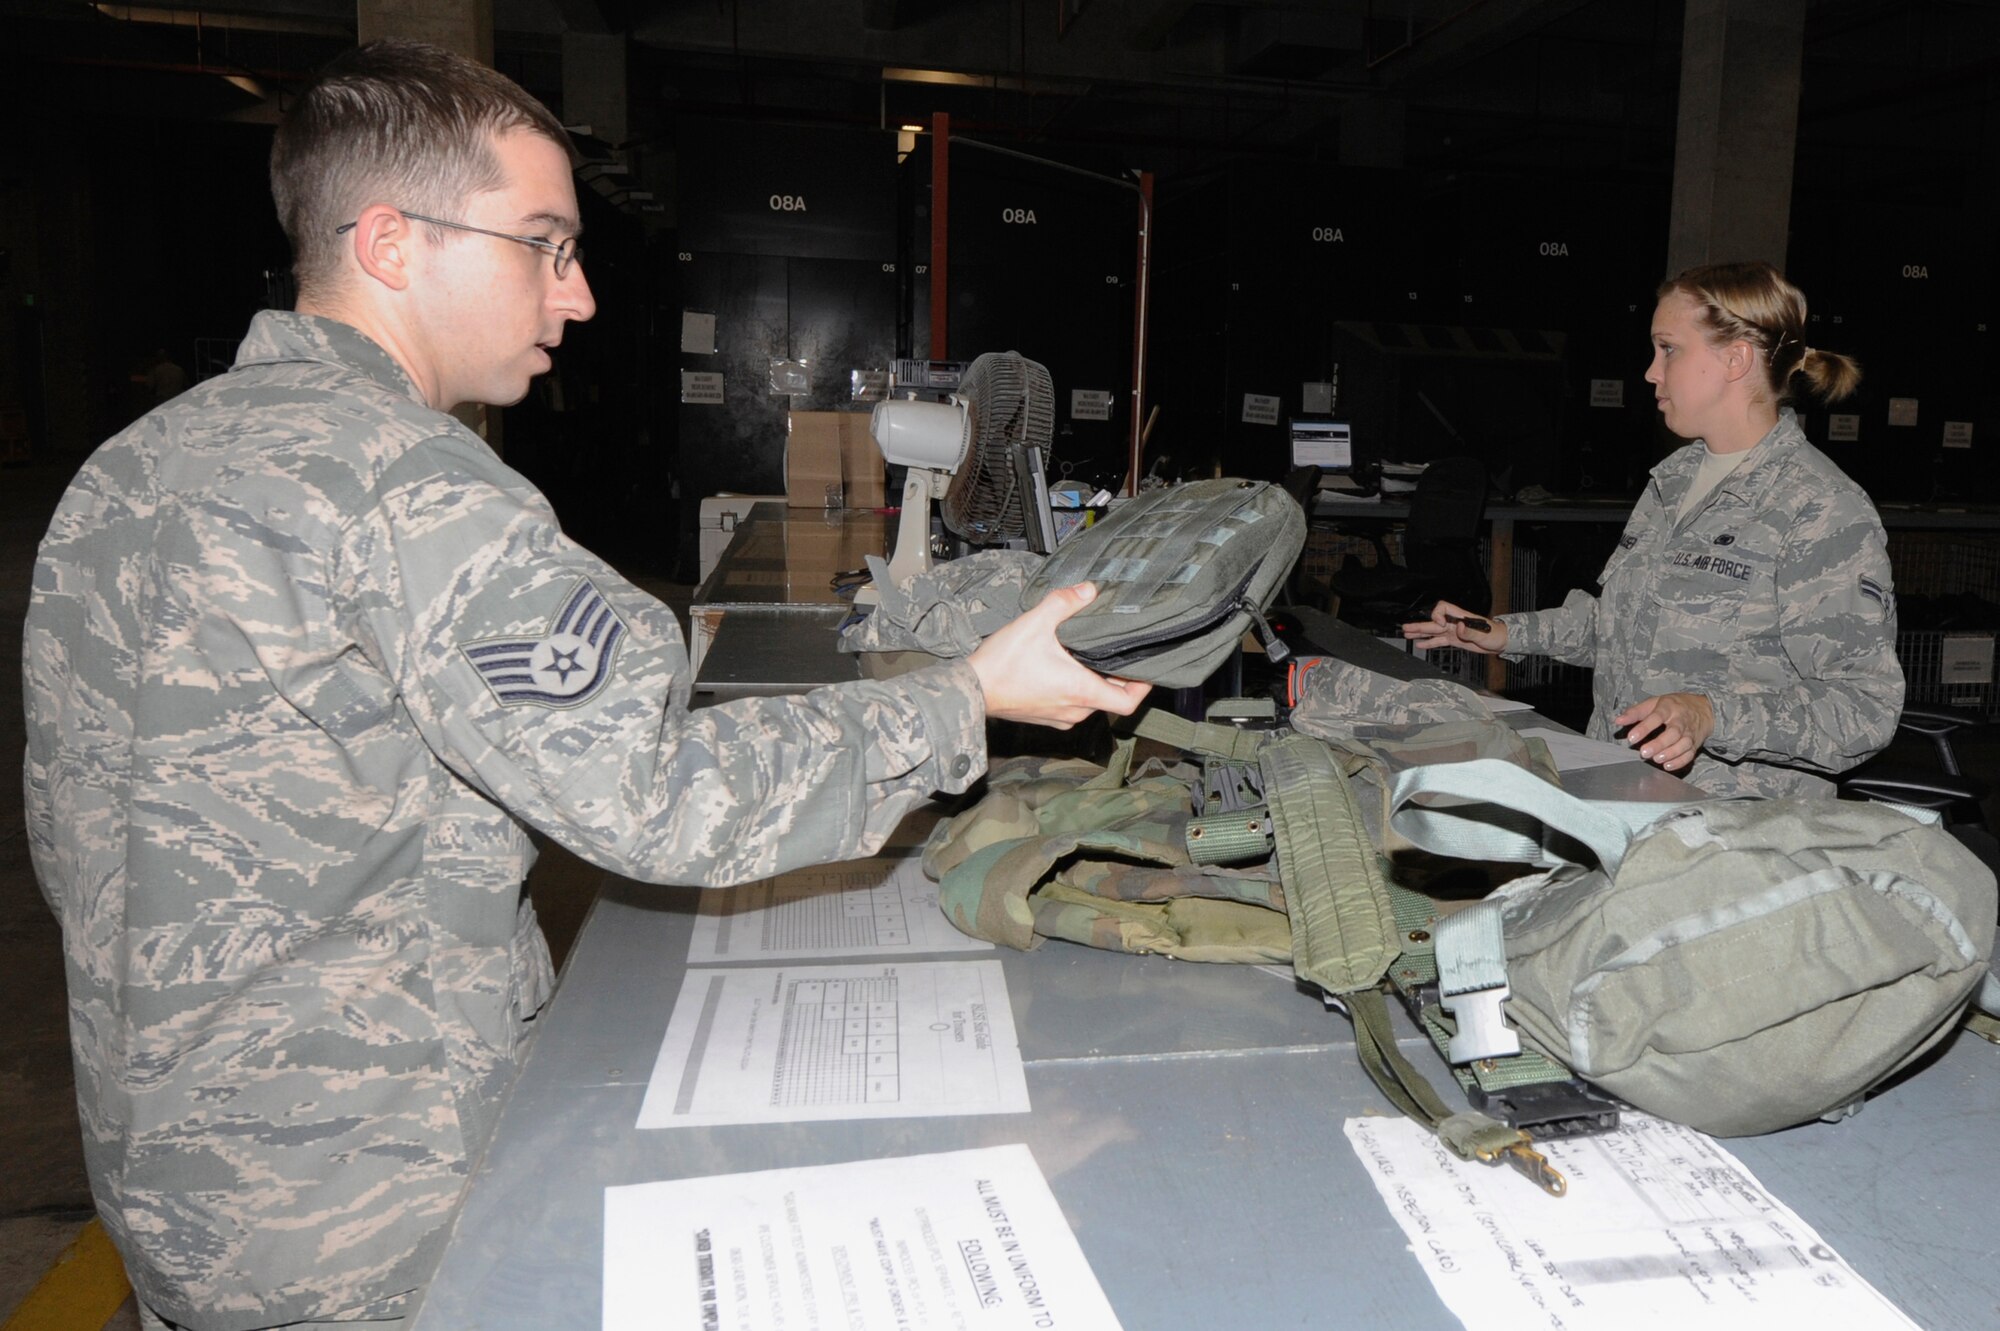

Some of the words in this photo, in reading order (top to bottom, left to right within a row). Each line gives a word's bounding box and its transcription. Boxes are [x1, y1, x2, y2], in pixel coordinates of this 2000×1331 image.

[770, 195, 806, 211] 08A
[1003, 208, 1036, 224] 08A
[1313, 227, 1343, 242] 08A
[1540, 242, 1568, 256] 08A
[678, 253, 693, 262] 03
[882, 264, 896, 273] 05
[915, 266, 928, 274] 07
[1903, 265, 1928, 278] 08A
[1105, 276, 1119, 284] 09
[1673, 552, 1693, 567] U.S.
[1693, 556, 1711, 571] AIR
[1711, 558, 1752, 581] FORCE
[974, 1178, 993, 1196] ALL
[983, 1197, 1008, 1224] MUST
[995, 1225, 1015, 1238] BE
[874, 1239, 889, 1257] HAVE
[1001, 1239, 1020, 1251] IN
[879, 1258, 895, 1276] COPY
[957, 1239, 1004, 1309] FOLLOWING:
[886, 1278, 898, 1287] OF
[1007, 1253, 1043, 1308] UNIFORM
[887, 1288, 907, 1316] ORDERS
[1032, 1310, 1055, 1328] TO
